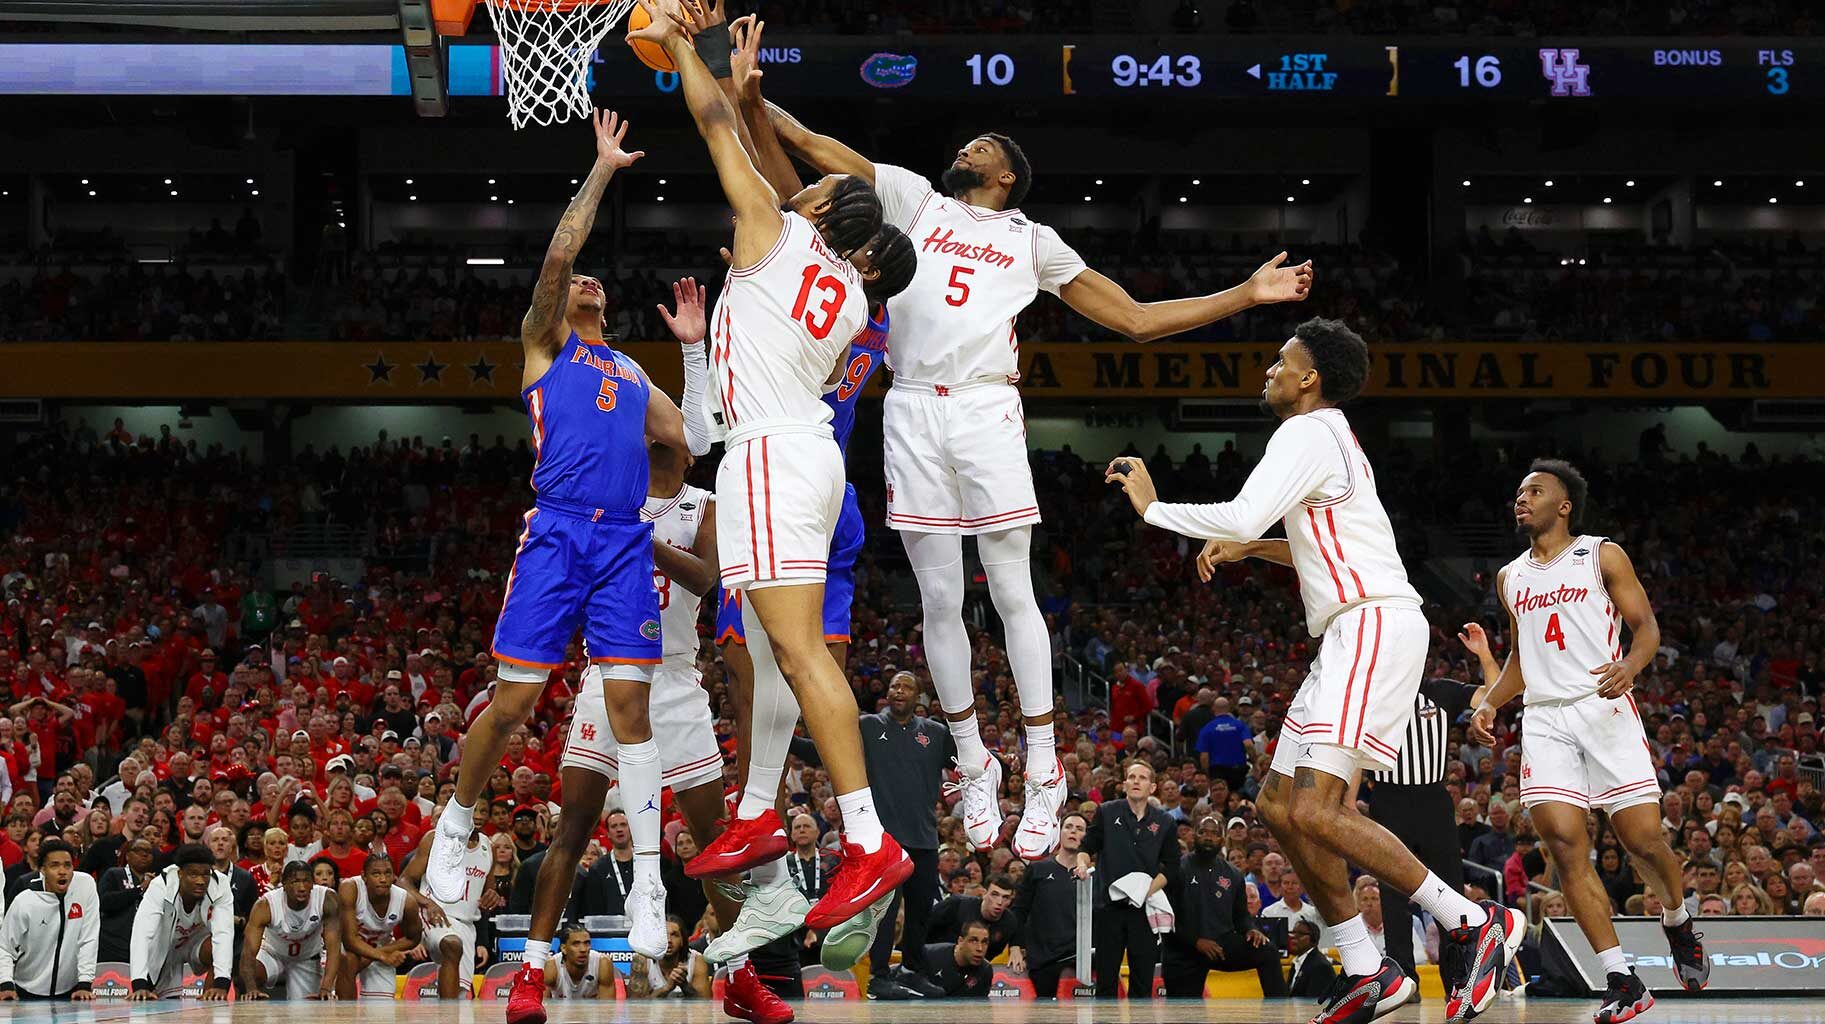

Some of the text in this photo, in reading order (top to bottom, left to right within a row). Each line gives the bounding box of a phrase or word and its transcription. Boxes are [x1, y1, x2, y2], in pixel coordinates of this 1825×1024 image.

[965, 54, 1015, 85] 10
[1111, 54, 1202, 87] 9:43
[1280, 54, 1327, 71] 1ST
[1454, 56, 1501, 87] 16
[1654, 50, 1722, 65] BONUS
[1758, 50, 1794, 65] FLS
[1267, 73, 1338, 90] HALF
[1767, 66, 1790, 94] 3
[922, 226, 1015, 269] Houston
[791, 263, 847, 340] 13
[945, 265, 975, 307] 5
[838, 352, 872, 402] 9
[1092, 352, 1262, 388] MEN'
[1383, 352, 1553, 388] INAL
[1587, 352, 1771, 388] FOUR
[596, 377, 619, 412] 5
[1514, 583, 1588, 617] Houston
[1544, 612, 1566, 651] 4
